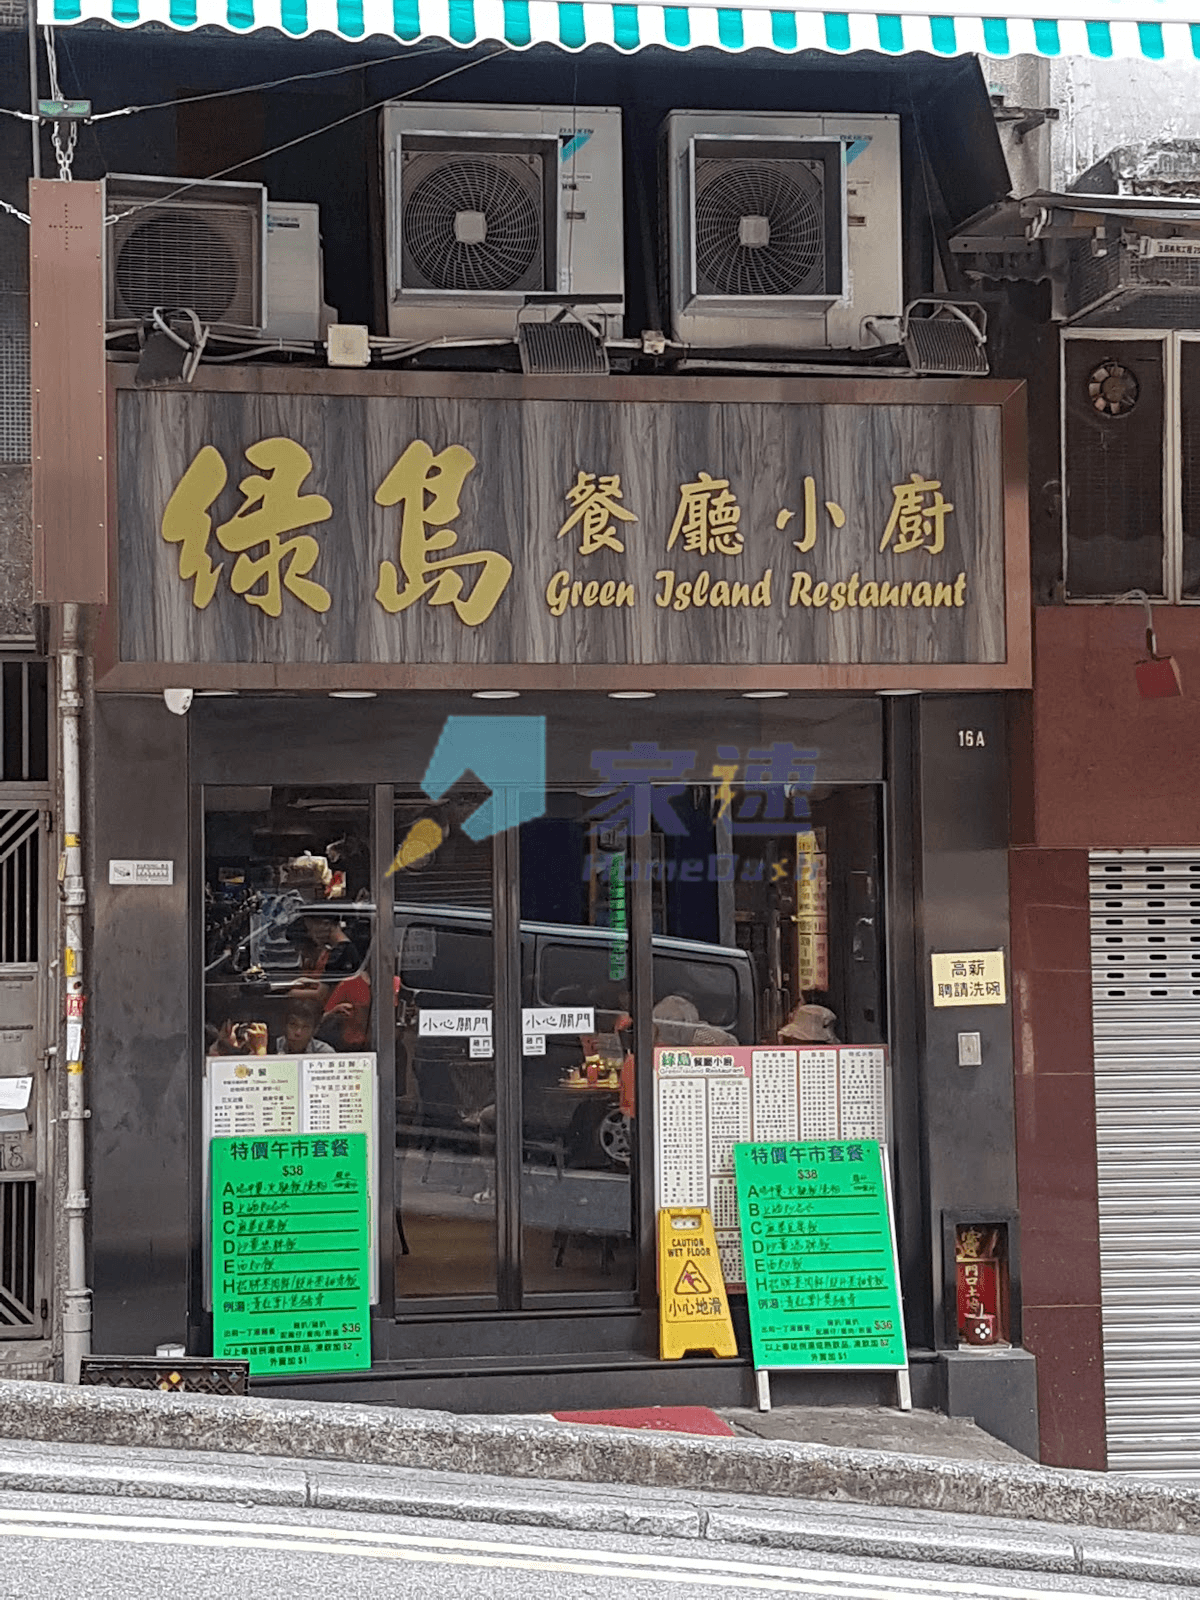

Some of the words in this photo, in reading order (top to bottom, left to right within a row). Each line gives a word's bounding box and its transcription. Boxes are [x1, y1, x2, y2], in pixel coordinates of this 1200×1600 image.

[557, 471, 954, 556] 餐廳小廚
[546, 570, 635, 616] Green
[655, 570, 772, 608] Island
[790, 571, 966, 611] Restaurant
[958, 730, 985, 747] 16A
[950, 959, 985, 978] 高薪
[938, 981, 1001, 998] 聘請洗碗
[230, 1139, 349, 1160] 特價午市套餐
[751, 1144, 864, 1165] 特價午市套餐
[282, 1165, 304, 1177] $38
[797, 1169, 818, 1180] $38
[223, 1182, 235, 1196] A
[748, 1185, 760, 1198] A
[223, 1201, 234, 1215] B
[749, 1203, 760, 1216] B
[223, 1220, 235, 1234] C
[751, 1221, 762, 1235] C
[223, 1240, 235, 1254] D
[672, 1238, 704, 1247] CAUTION
[752, 1240, 764, 1254] D
[667, 1248, 683, 1257] WET
[687, 1247, 711, 1257] FLOOR
[224, 1259, 235, 1273] E
[755, 1259, 766, 1272] E
[223, 1279, 235, 1293] H
[756, 1278, 767, 1291] H
[669, 1297, 722, 1317] 小心地滑
